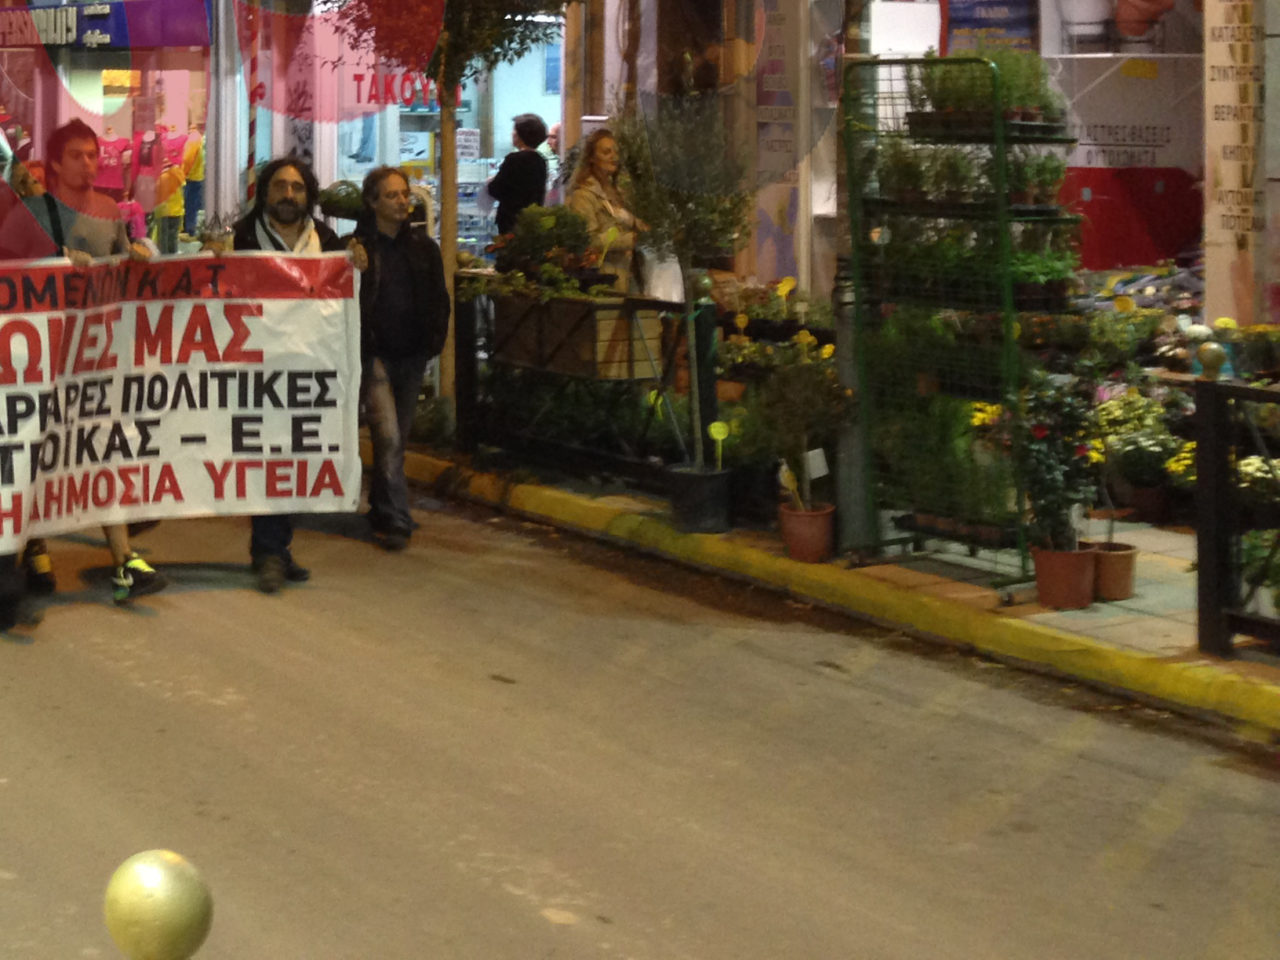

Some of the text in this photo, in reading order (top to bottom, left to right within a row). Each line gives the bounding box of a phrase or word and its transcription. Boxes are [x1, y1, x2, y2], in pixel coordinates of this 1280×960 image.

[133, 303, 264, 368] ΜΑΣ
[121, 370, 338, 414] ΠΟΛΙΤΙΚΕΣ
[230, 415, 340, 454] Ε.Ε.
[204, 459, 346, 500] ΥΓΕΙΑ
